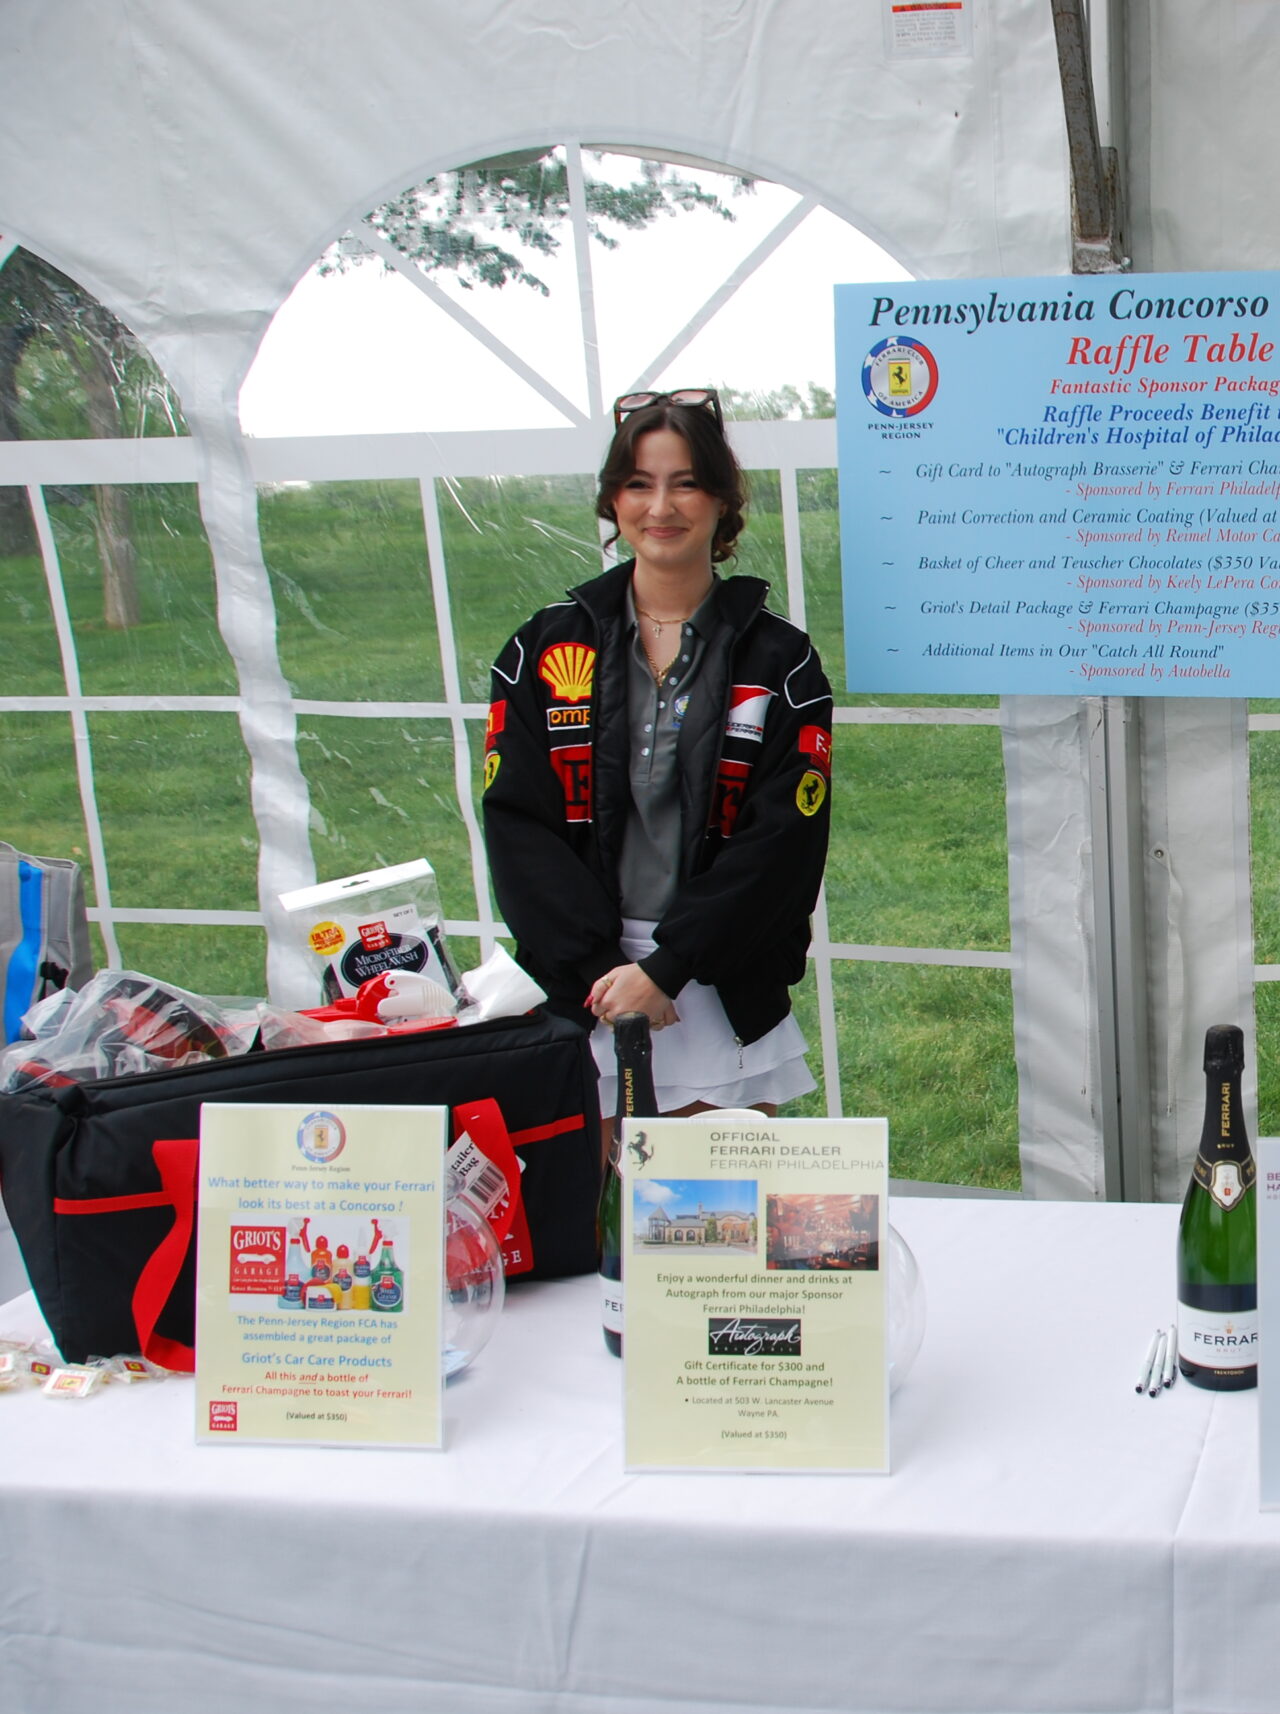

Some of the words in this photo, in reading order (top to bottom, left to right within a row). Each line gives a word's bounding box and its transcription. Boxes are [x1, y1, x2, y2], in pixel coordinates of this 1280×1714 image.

[868, 292, 1095, 334] Pennsylvania
[1109, 291, 1269, 320] Concorso
[1066, 334, 1170, 376] Raffle
[1183, 332, 1275, 363] Table
[1050, 377, 1132, 394] Fantastic
[1137, 377, 1208, 399] Sponsor
[890, 390, 924, 407] AMERICA
[1041, 404, 1103, 429] Raffle
[1108, 402, 1194, 422] Proceeds
[1200, 402, 1270, 425] Benefit
[868, 422, 933, 431] PENN-JERSEY
[881, 432, 921, 440] REGION
[997, 426, 1099, 446] "Children's
[1106, 425, 1190, 449] Hospital
[1194, 425, 1217, 449] of
[916, 463, 943, 482] Gift
[948, 462, 984, 478] Card
[988, 465, 1001, 477] to
[1005, 461, 1087, 481] "Autograph
[1093, 460, 1164, 476] Brasserie"
[1169, 460, 1185, 476] &
[1190, 460, 1243, 475] Ferrari
[1076, 481, 1143, 501] Sponsored
[1147, 480, 1161, 501] by
[1166, 481, 1214, 496] Ferrari
[917, 509, 956, 525] Paint
[961, 508, 1034, 525] Correction
[1038, 508, 1067, 524] and
[1072, 508, 1131, 524] Ceramic
[1136, 507, 1195, 529] Coating
[1199, 507, 1258, 526] (Valued
[1262, 510, 1277, 523] at
[1077, 574, 1144, 594] Sponsored
[1148, 574, 1162, 594] by
[1167, 574, 1202, 594] Keely
[1206, 575, 1255, 589] LePera
[1079, 663, 1146, 681] Sponsored
[1150, 663, 1164, 682] by
[1167, 663, 1231, 678] Autobella
[625, 1067, 634, 1118] FERRARI
[1221, 1082, 1231, 1137] FERRARI
[710, 1131, 780, 1142] OFFICIAL
[710, 1145, 776, 1156] FERRARI
[779, 1146, 841, 1156] DEALER
[458, 1156, 480, 1178] Bag
[710, 1158, 772, 1170] FERRARI
[777, 1159, 885, 1171] PHILADELPHIA
[208, 1178, 241, 1189] What
[243, 1178, 281, 1190] better
[285, 1181, 310, 1192] way
[312, 1180, 325, 1190] to
[327, 1179, 361, 1190] make
[364, 1182, 393, 1194] your
[394, 1180, 436, 1192] Ferrari
[233, 1230, 281, 1250] GRIOT'S
[234, 1267, 280, 1276] GARAGE
[657, 1273, 685, 1285] Enjoy
[687, 1275, 693, 1283] a
[695, 1273, 748, 1284] wonderful
[750, 1274, 783, 1284] dinner
[786, 1274, 806, 1284] and
[808, 1274, 840, 1285] drinks
[842, 1275, 852, 1284] at
[709, 1317, 801, 1355] Autograph
[241, 1352, 282, 1364] Griot's
[284, 1353, 305, 1368] Car
[307, 1354, 335, 1366] Care
[338, 1354, 393, 1367] Products
[684, 1360, 703, 1370] Gift
[705, 1360, 758, 1371] Certificate
[760, 1361, 775, 1371] for
[778, 1361, 803, 1372] $300
[805, 1362, 825, 1372] and
[676, 1375, 684, 1385] A
[686, 1375, 717, 1386] bottle
[719, 1375, 730, 1386] of
[732, 1376, 767, 1386] Ferrari
[768, 1376, 833, 1389] Champagne!
[286, 1411, 316, 1420] (Valued
